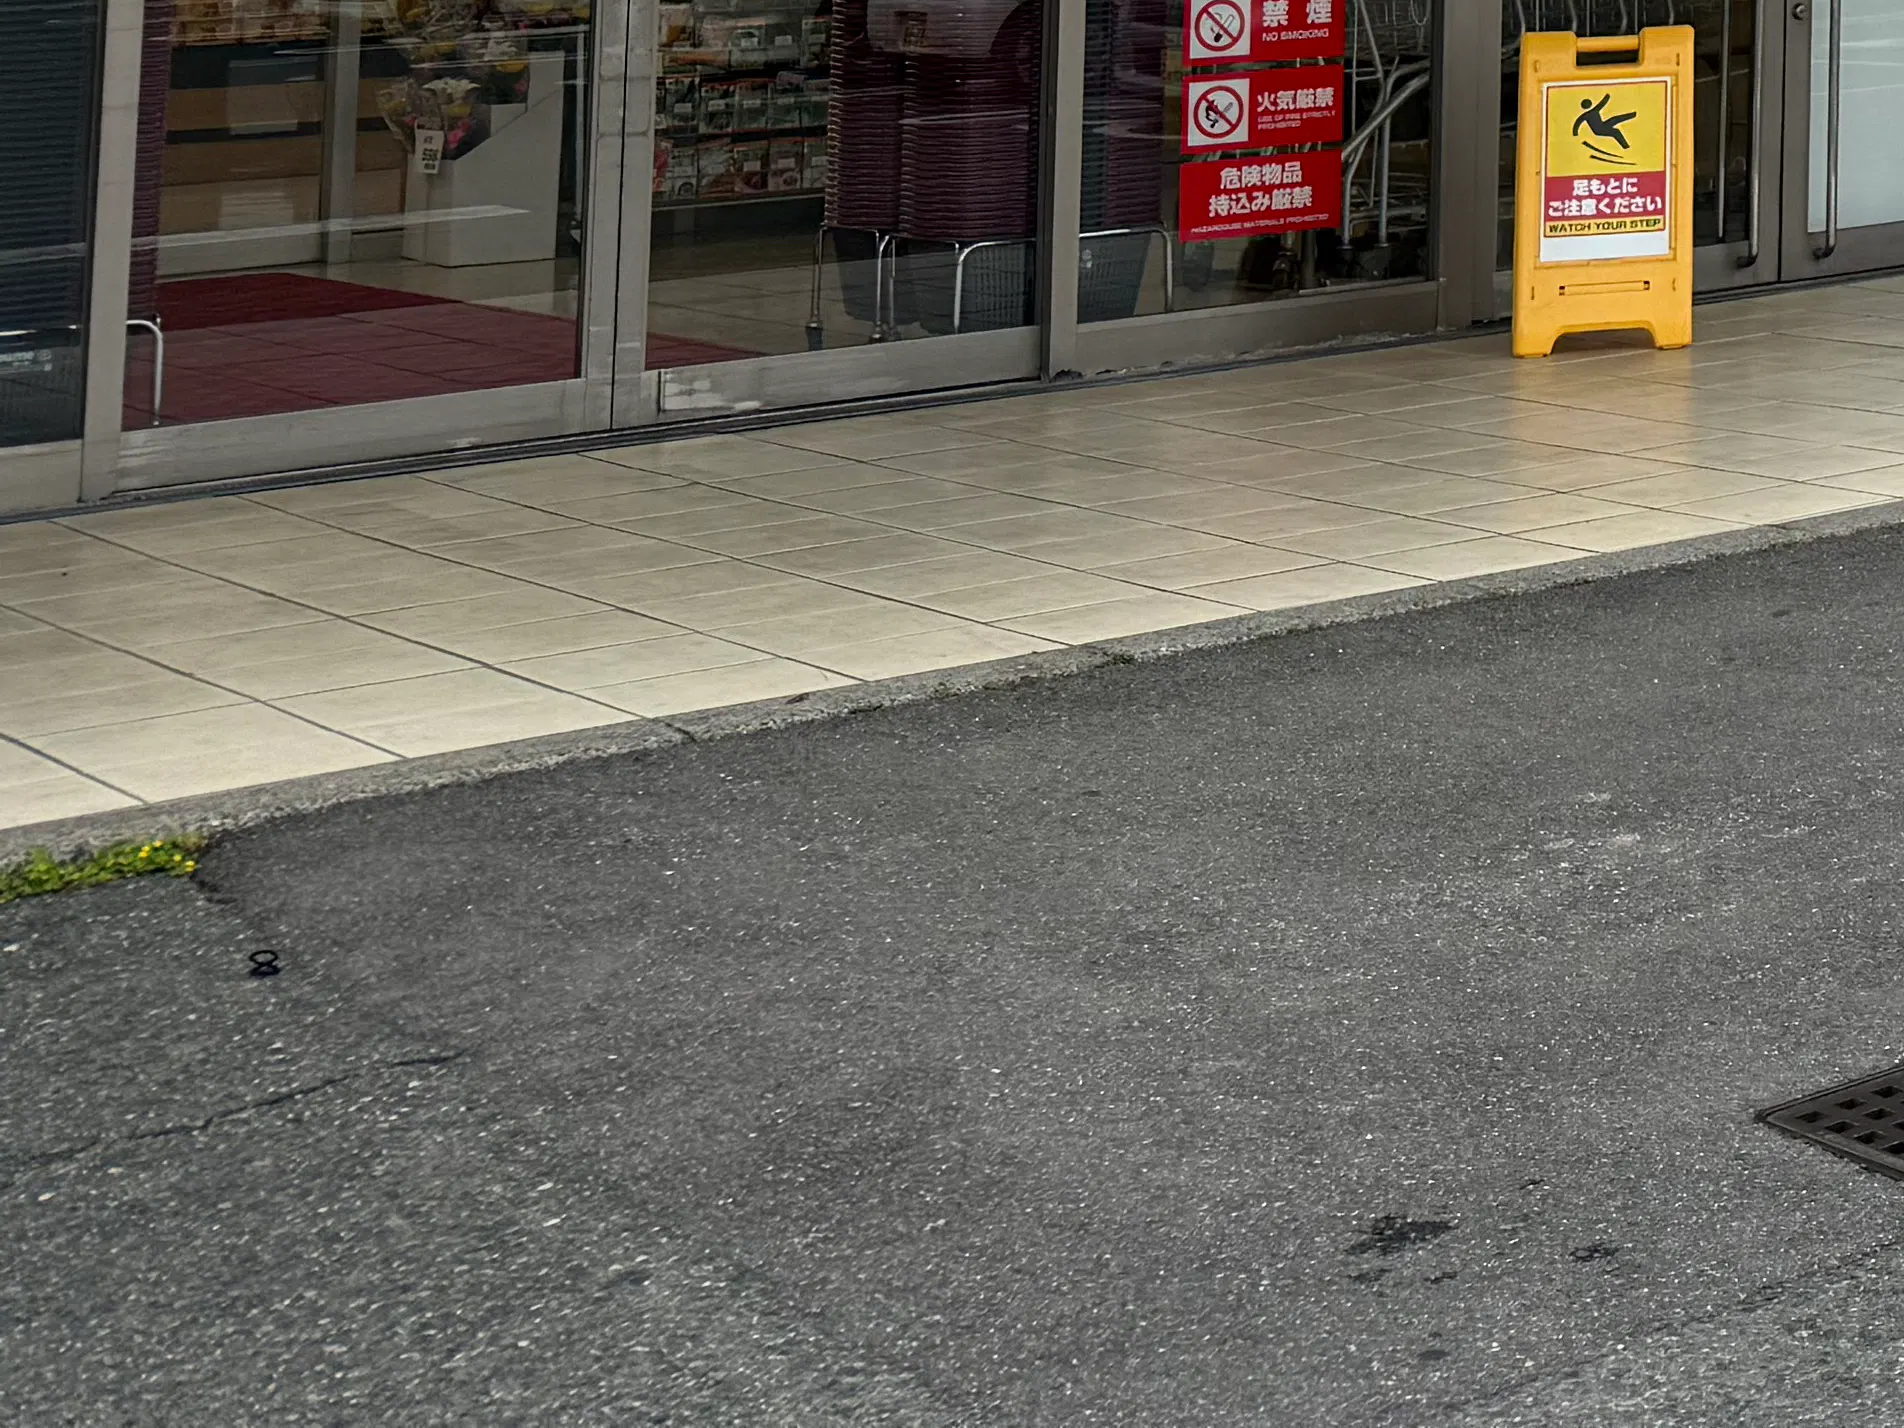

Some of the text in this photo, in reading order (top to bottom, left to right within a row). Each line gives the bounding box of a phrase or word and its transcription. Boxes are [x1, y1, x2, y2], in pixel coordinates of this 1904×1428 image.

[1262, 28, 1330, 42] NO SMOKING
[1257, 87, 1335, 113] 火気厳禁
[1220, 161, 1303, 190] 危険物品
[1572, 177, 1638, 197] 足もとに
[1208, 186, 1313, 218] 持込み厳禁
[1548, 195, 1663, 218] ご注意ください
[1548, 218, 1662, 234] WATCH YOUR STEP
